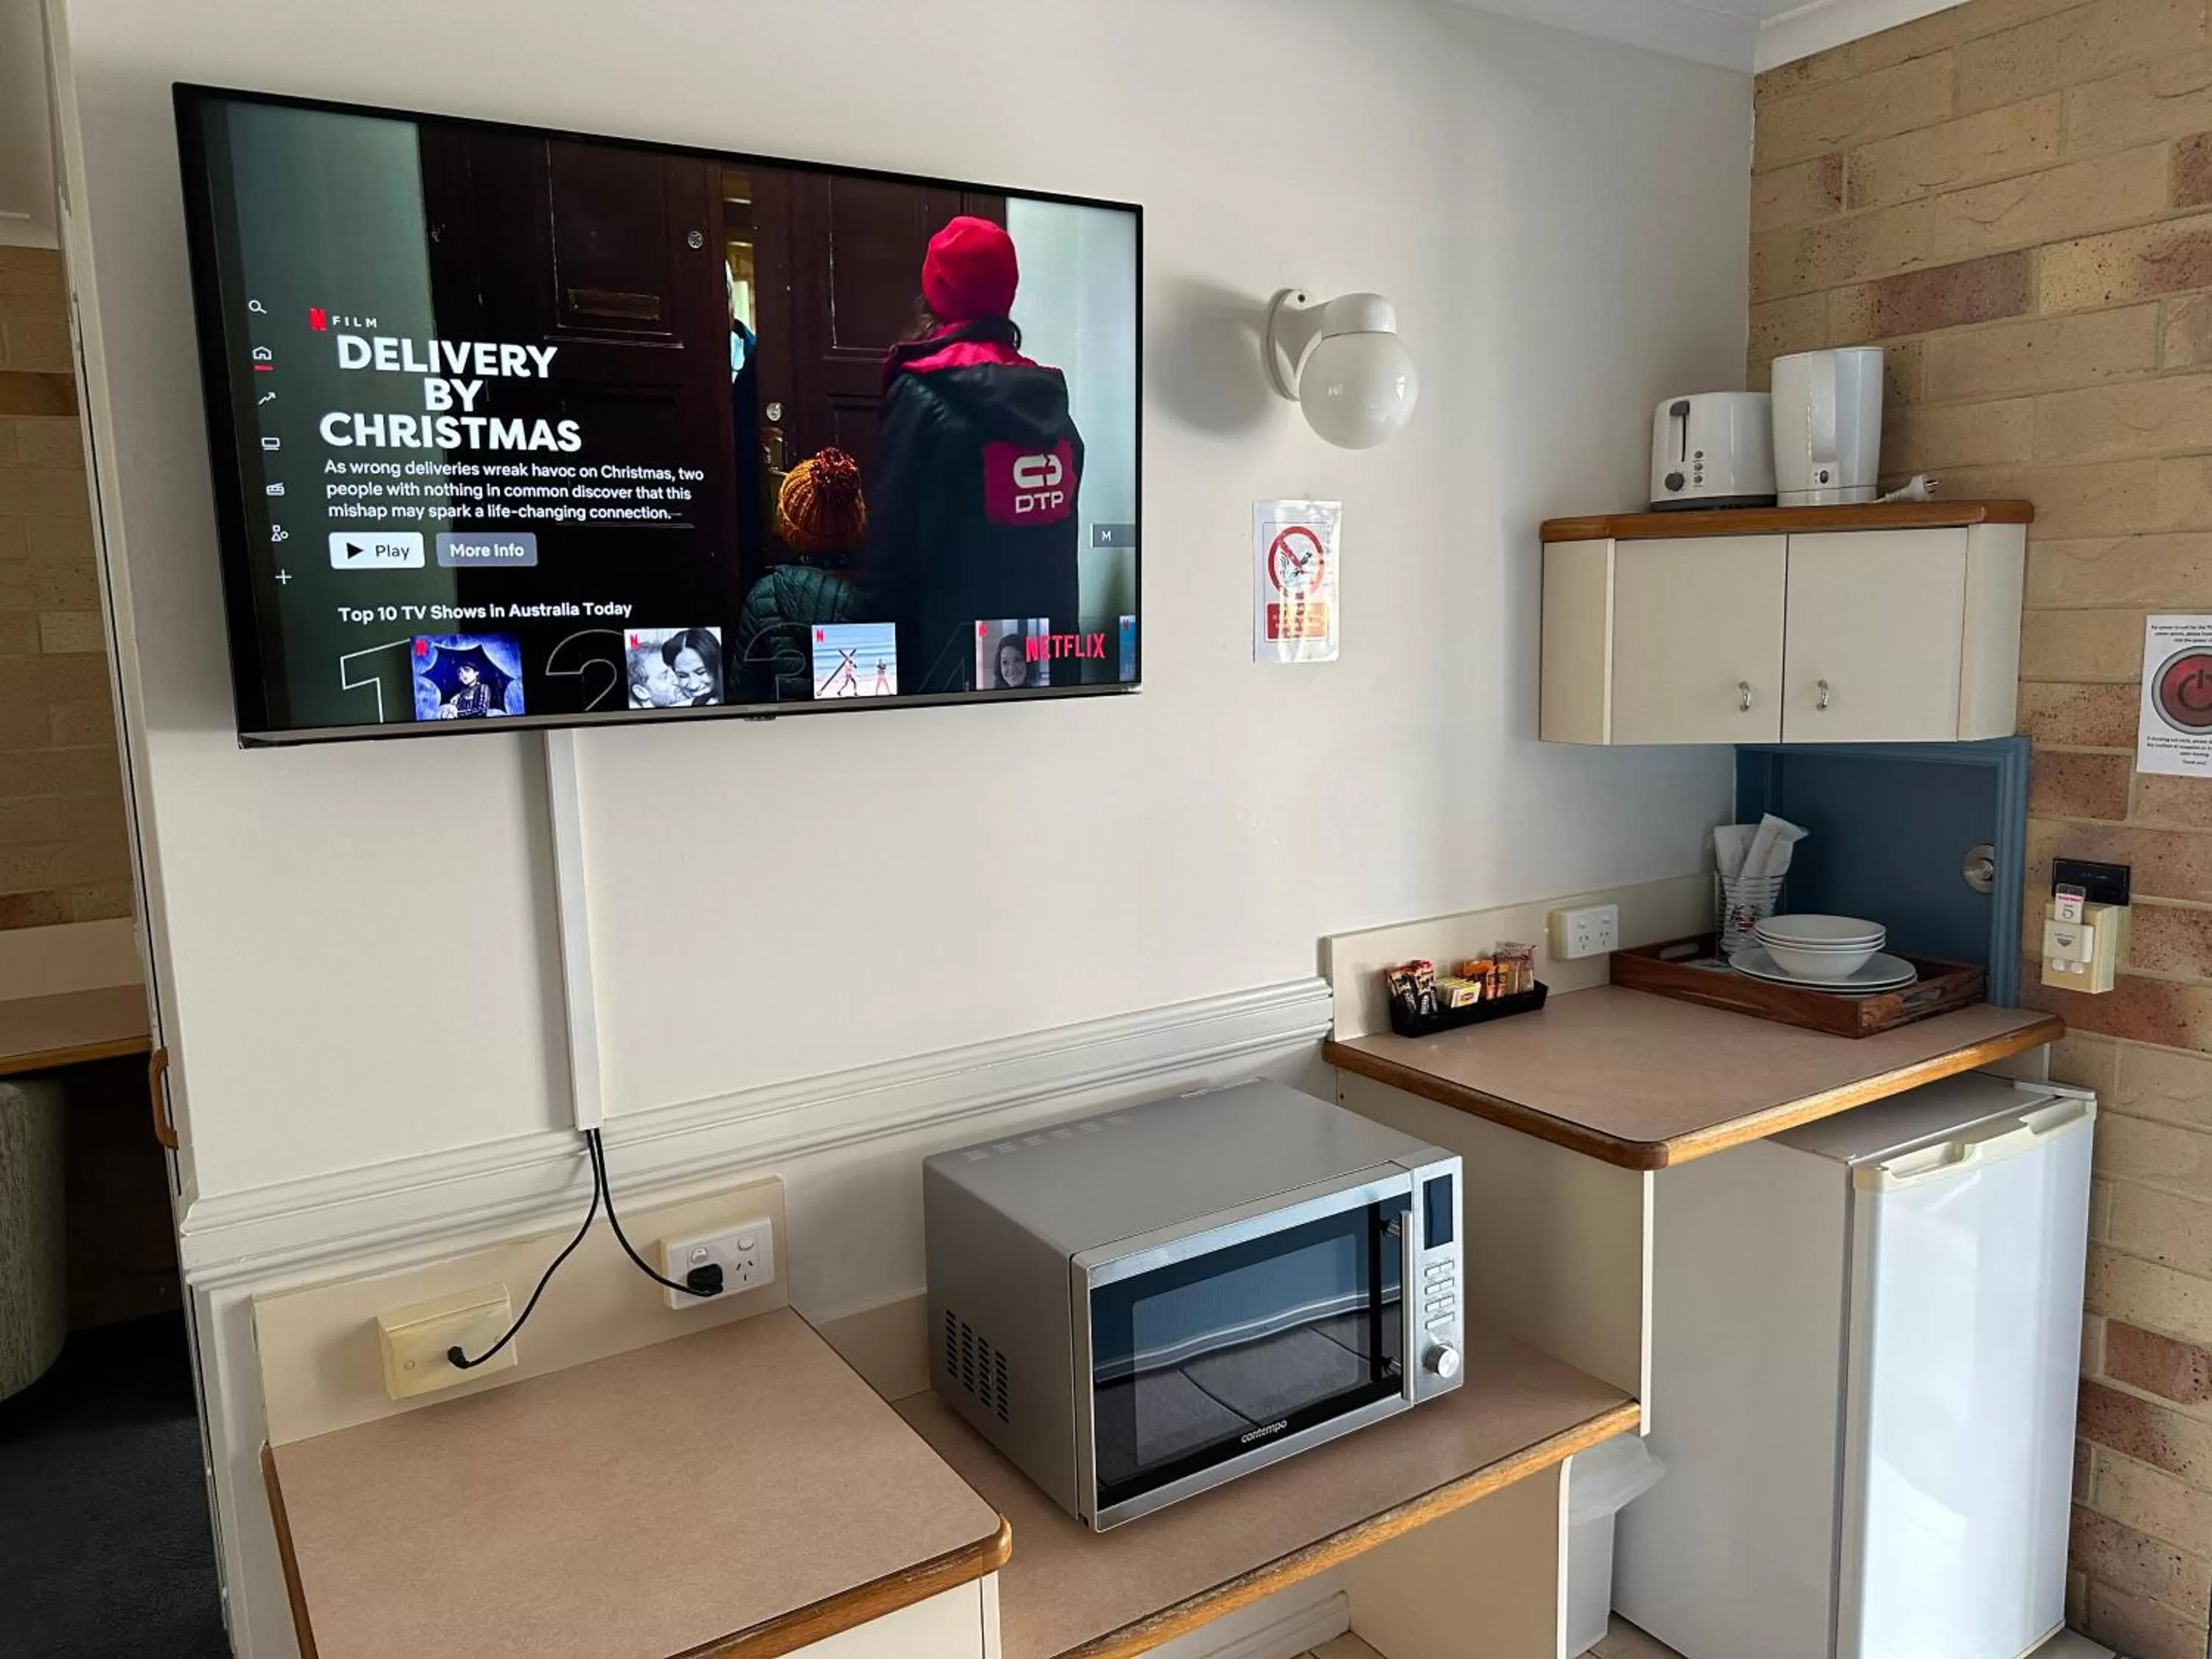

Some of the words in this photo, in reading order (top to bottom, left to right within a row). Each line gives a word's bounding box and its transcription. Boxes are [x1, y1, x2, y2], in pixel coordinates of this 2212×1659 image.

[333, 316, 378, 329] FILM
[337, 335, 558, 378] DELIVERY
[424, 378, 483, 412] BY
[319, 411, 582, 453] CHRISTMAS
[324, 459, 347, 474] As
[349, 462, 401, 478] wrong
[406, 461, 479, 476] deliveries
[483, 463, 529, 476] wreak
[532, 463, 576, 477] havoc
[580, 466, 598, 478] on
[601, 465, 675, 482] Christmas,
[678, 467, 704, 480] two
[327, 482, 383, 499] people
[386, 482, 420, 496] with
[425, 483, 483, 500] nothing
[487, 484, 501, 496] in
[504, 486, 568, 498] common
[572, 485, 632, 499] discover
[636, 487, 664, 499] that
[667, 487, 692, 500] this
[1015, 491, 1063, 514] DTP
[328, 503, 387, 521] mishap
[392, 506, 425, 521] may
[428, 504, 472, 519] spark
[475, 507, 484, 518] a
[487, 504, 586, 521] life-changing
[590, 506, 672, 520] connection.
[1102, 530, 1111, 542] M
[375, 544, 410, 561] Play
[450, 543, 490, 557] More
[495, 543, 524, 557] Info
[338, 607, 374, 625] Top
[378, 606, 397, 620] 10
[401, 605, 427, 619] TV
[430, 604, 487, 619] Shows
[490, 603, 505, 618] in
[509, 602, 580, 617] Australia
[582, 602, 633, 618] Today
[1026, 632, 1106, 662] NETFLIX
[1241, 1419, 1287, 1443] contempo
